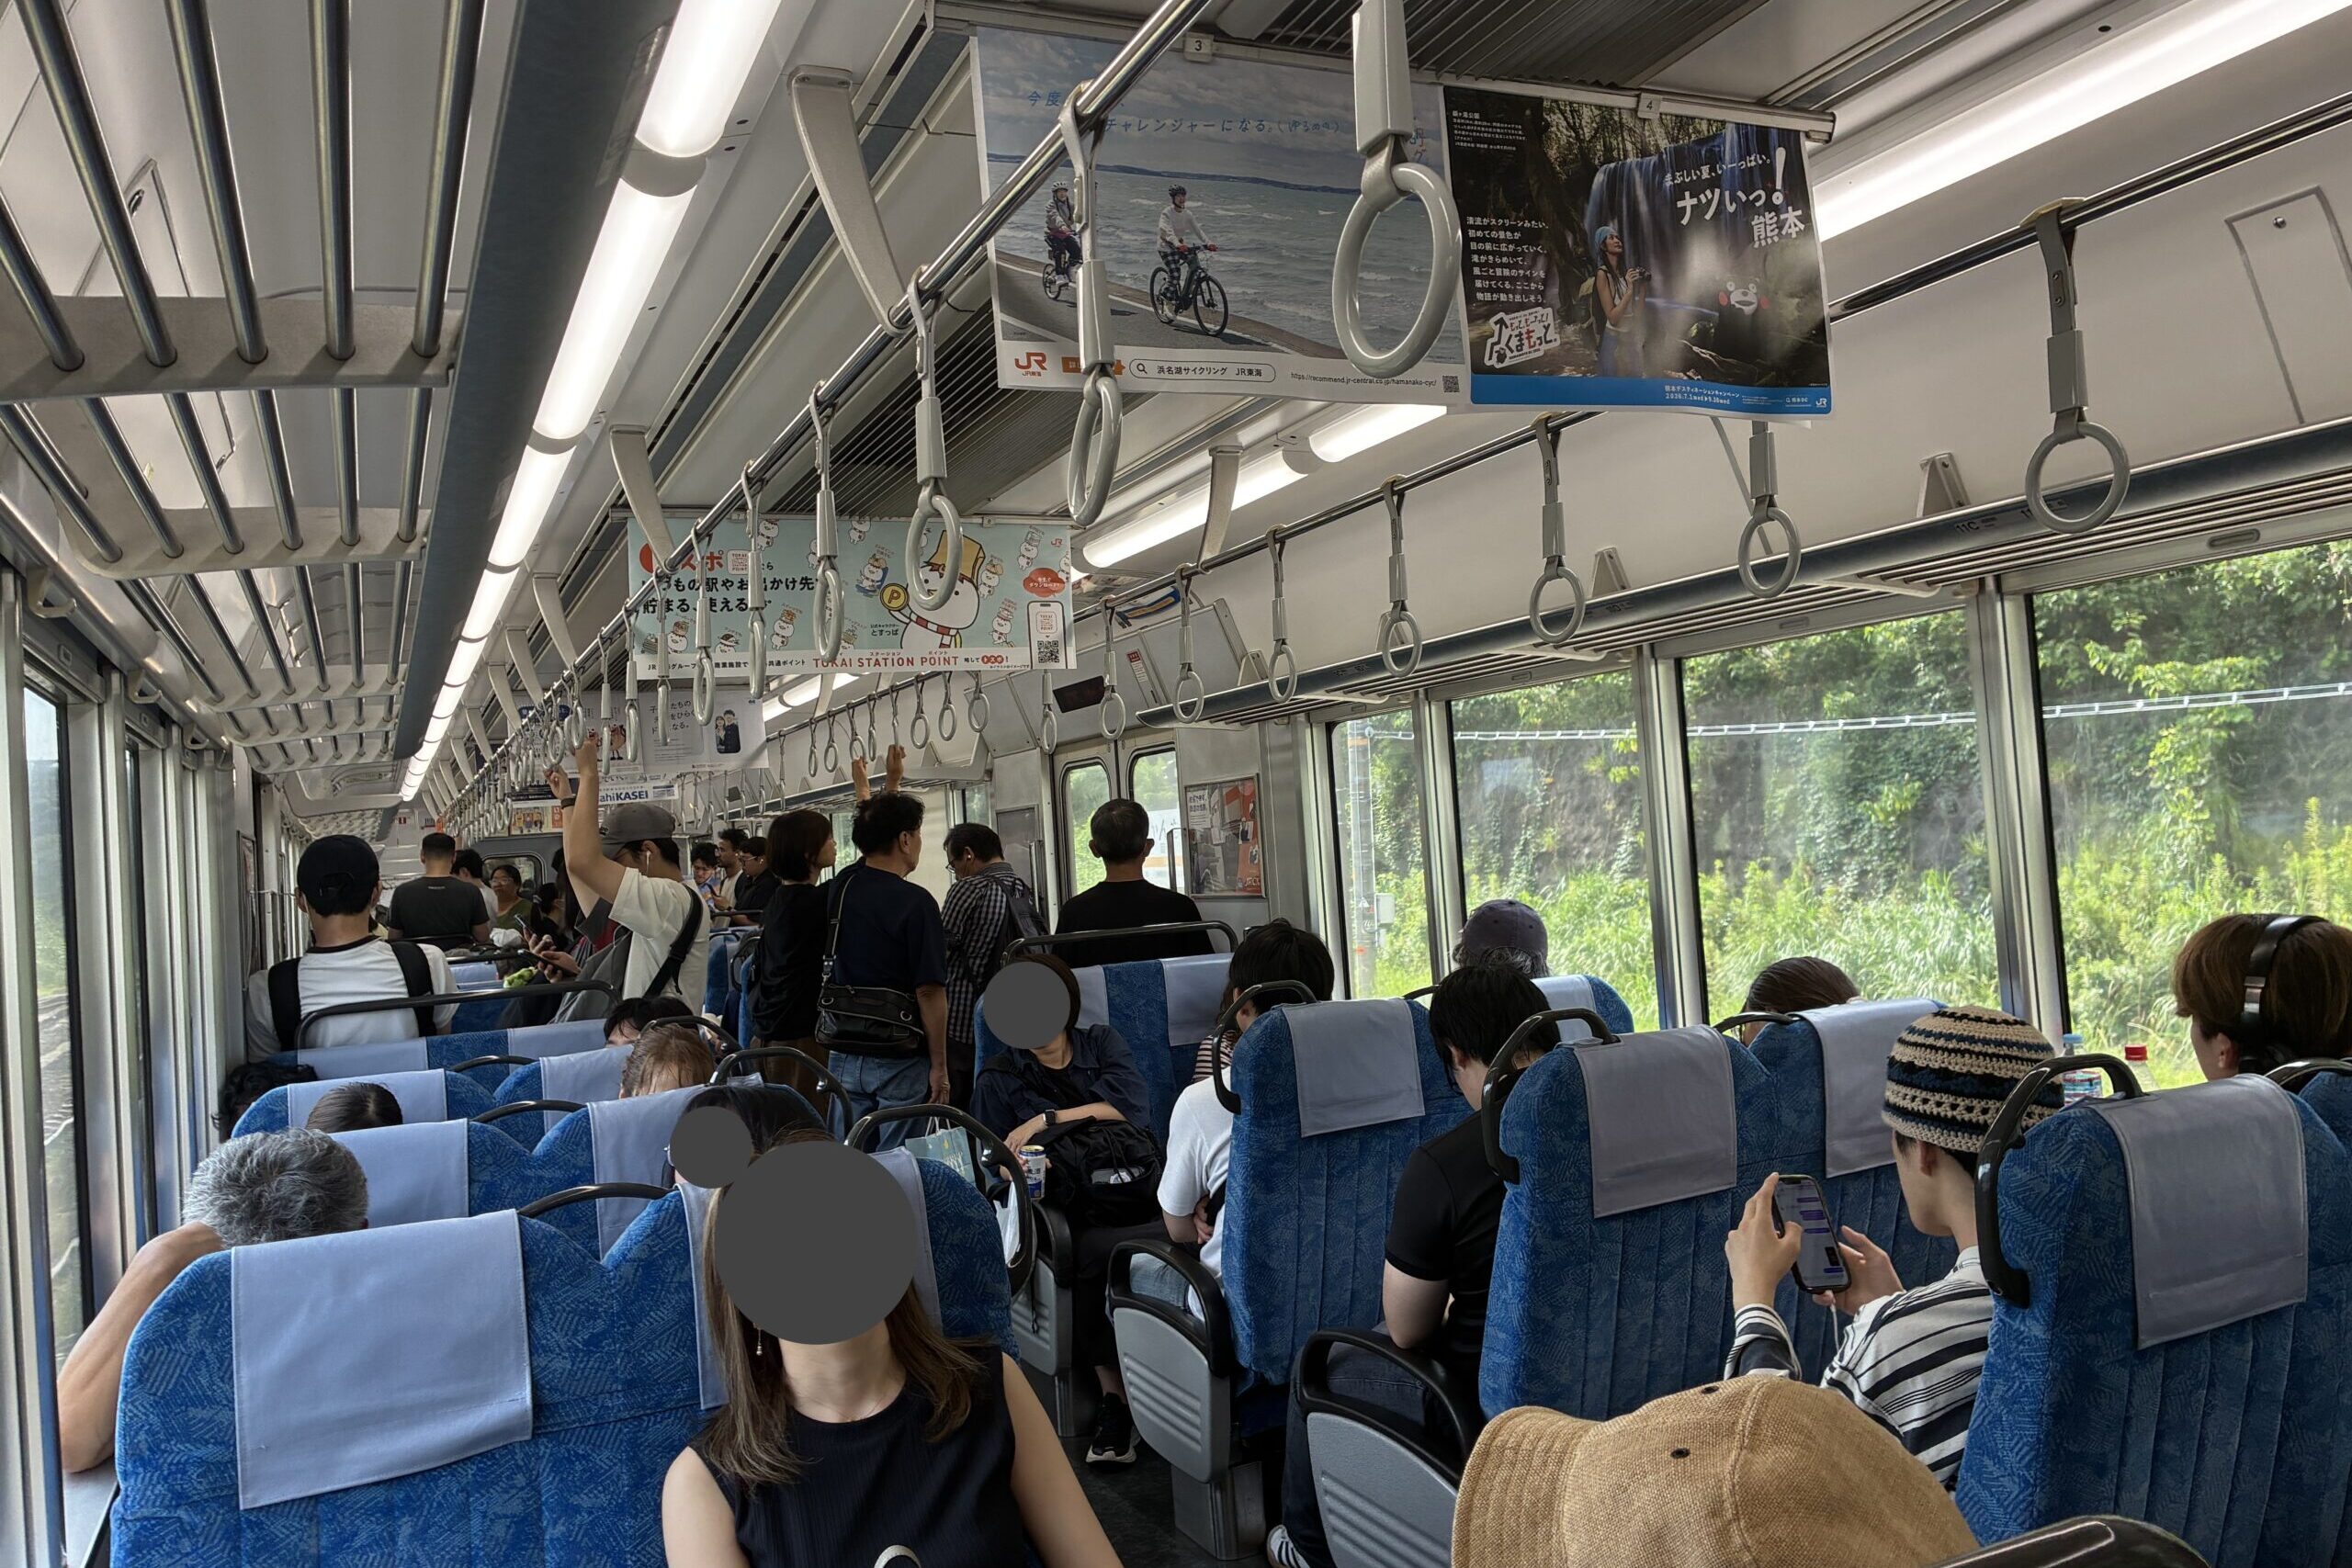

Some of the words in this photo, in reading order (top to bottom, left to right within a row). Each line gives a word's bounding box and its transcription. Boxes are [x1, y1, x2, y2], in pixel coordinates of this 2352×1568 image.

[1194, 39, 1202, 51] 3
[1645, 100, 1653, 110] 4
[1663, 152, 1770, 186] まぶしい夏、いーっぱい。
[1751, 206, 1805, 248] 熊本
[1468, 229, 1521, 240] 初めての景色が
[1470, 242, 1547, 254] 目の前に広がっていく。
[1476, 292, 1546, 303] 物語が動き出しそう。
[1505, 323, 1557, 354] くまもっと。
[1014, 352, 1047, 370] JR
[1157, 365, 1227, 376] 浜名湖サイクリング
[1236, 367, 1262, 377] JR東海
[1955, 521, 1980, 534] 11C
[857, 656, 915, 668] STATION
[920, 655, 959, 667] POINT
